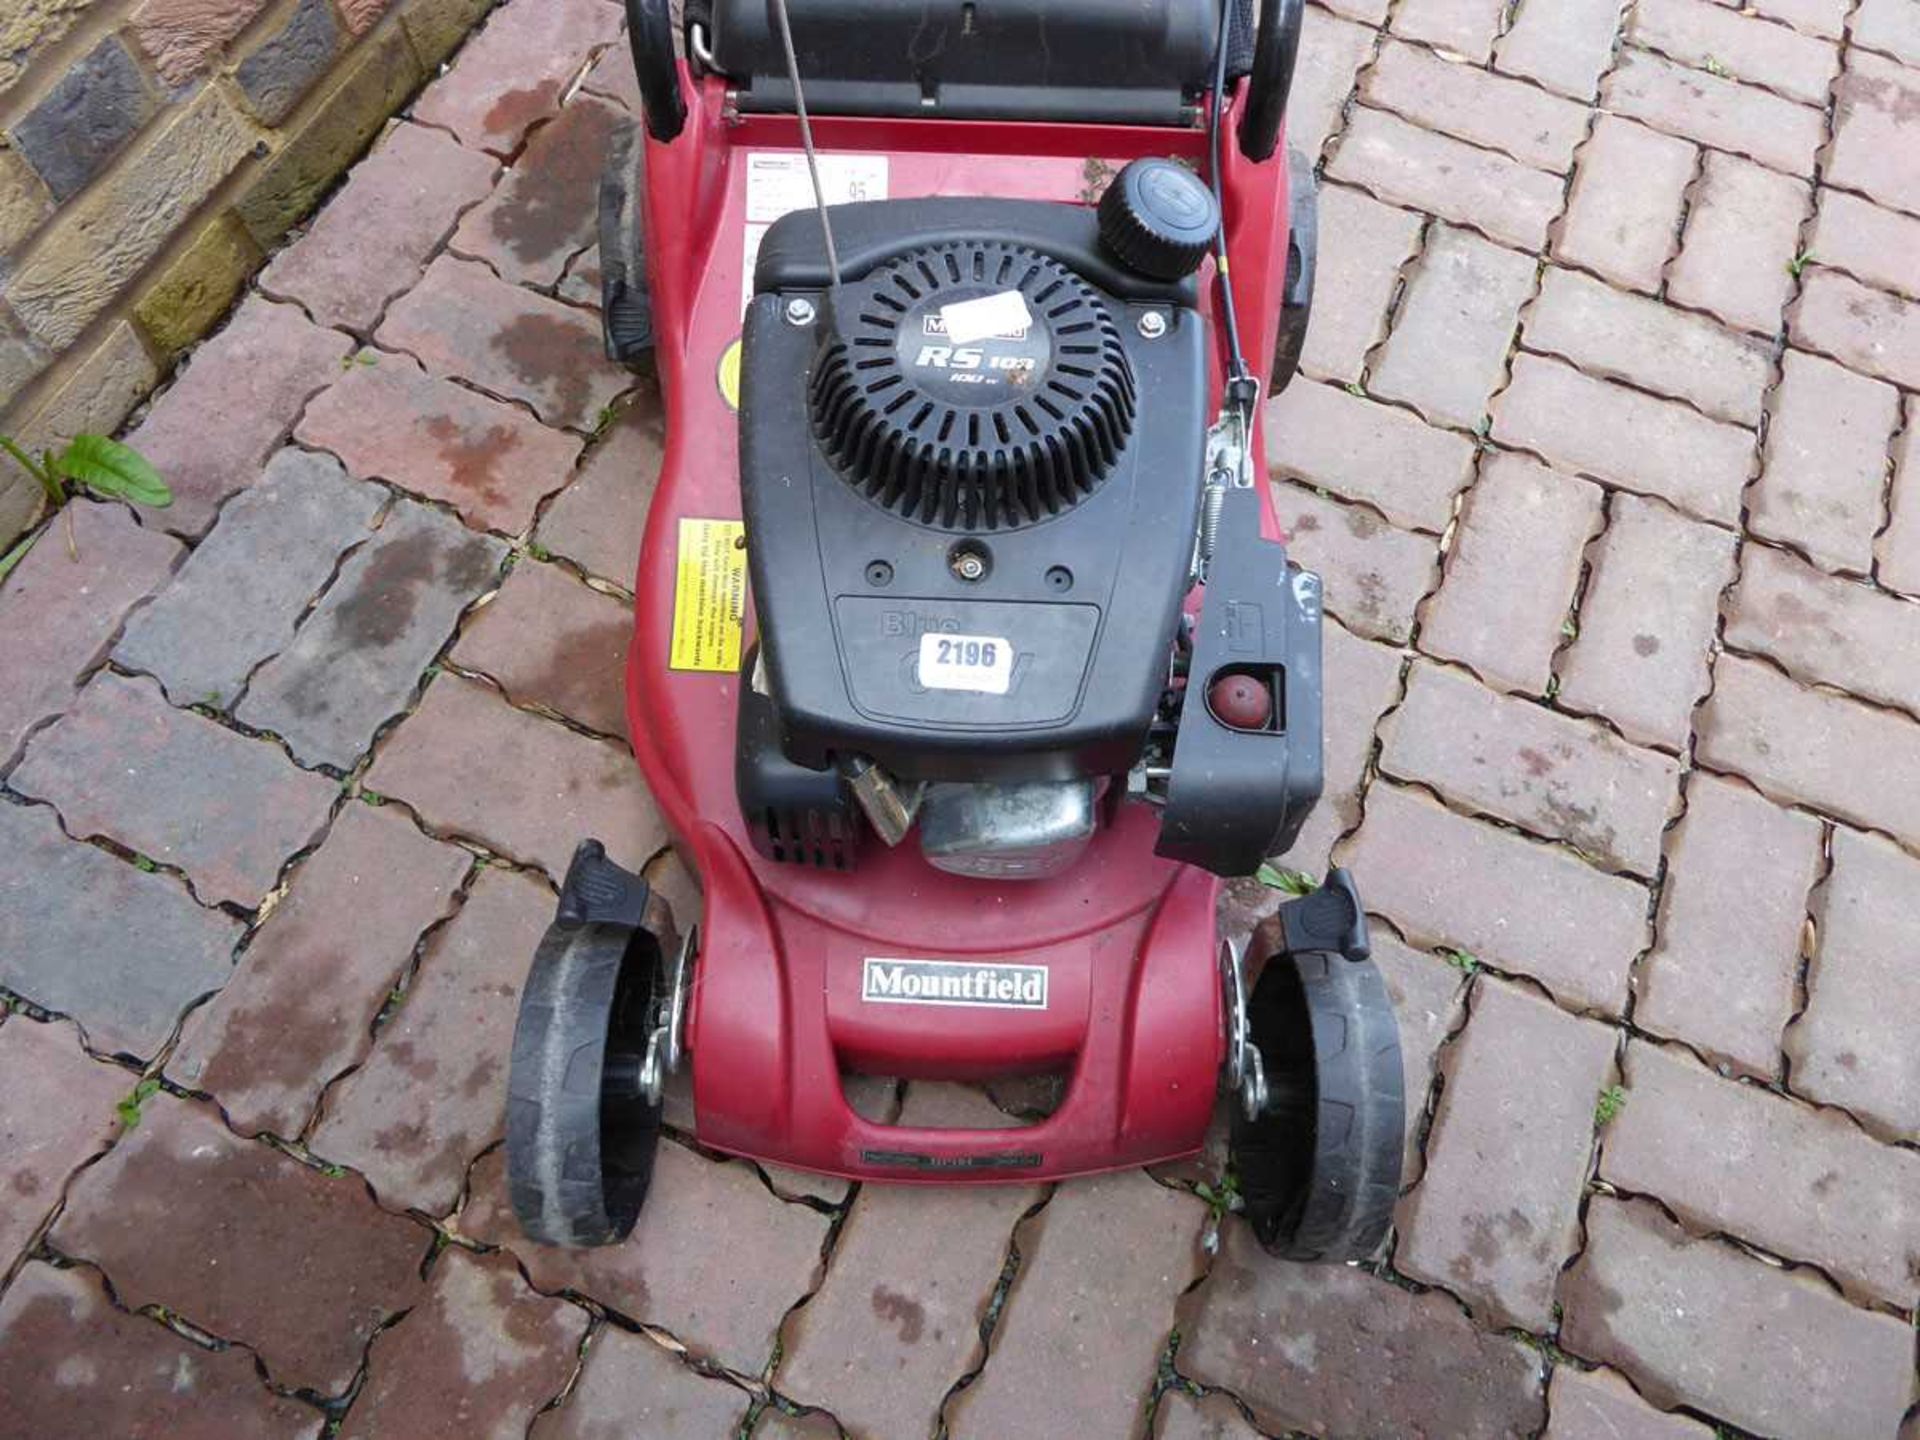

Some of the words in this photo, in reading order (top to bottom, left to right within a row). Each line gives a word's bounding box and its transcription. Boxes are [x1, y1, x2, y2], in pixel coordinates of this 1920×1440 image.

[916, 345, 984, 369] RS
[729, 568, 741, 622] WARNING
[936, 639, 997, 668] 2196
[868, 964, 1042, 1002] Mountfield
